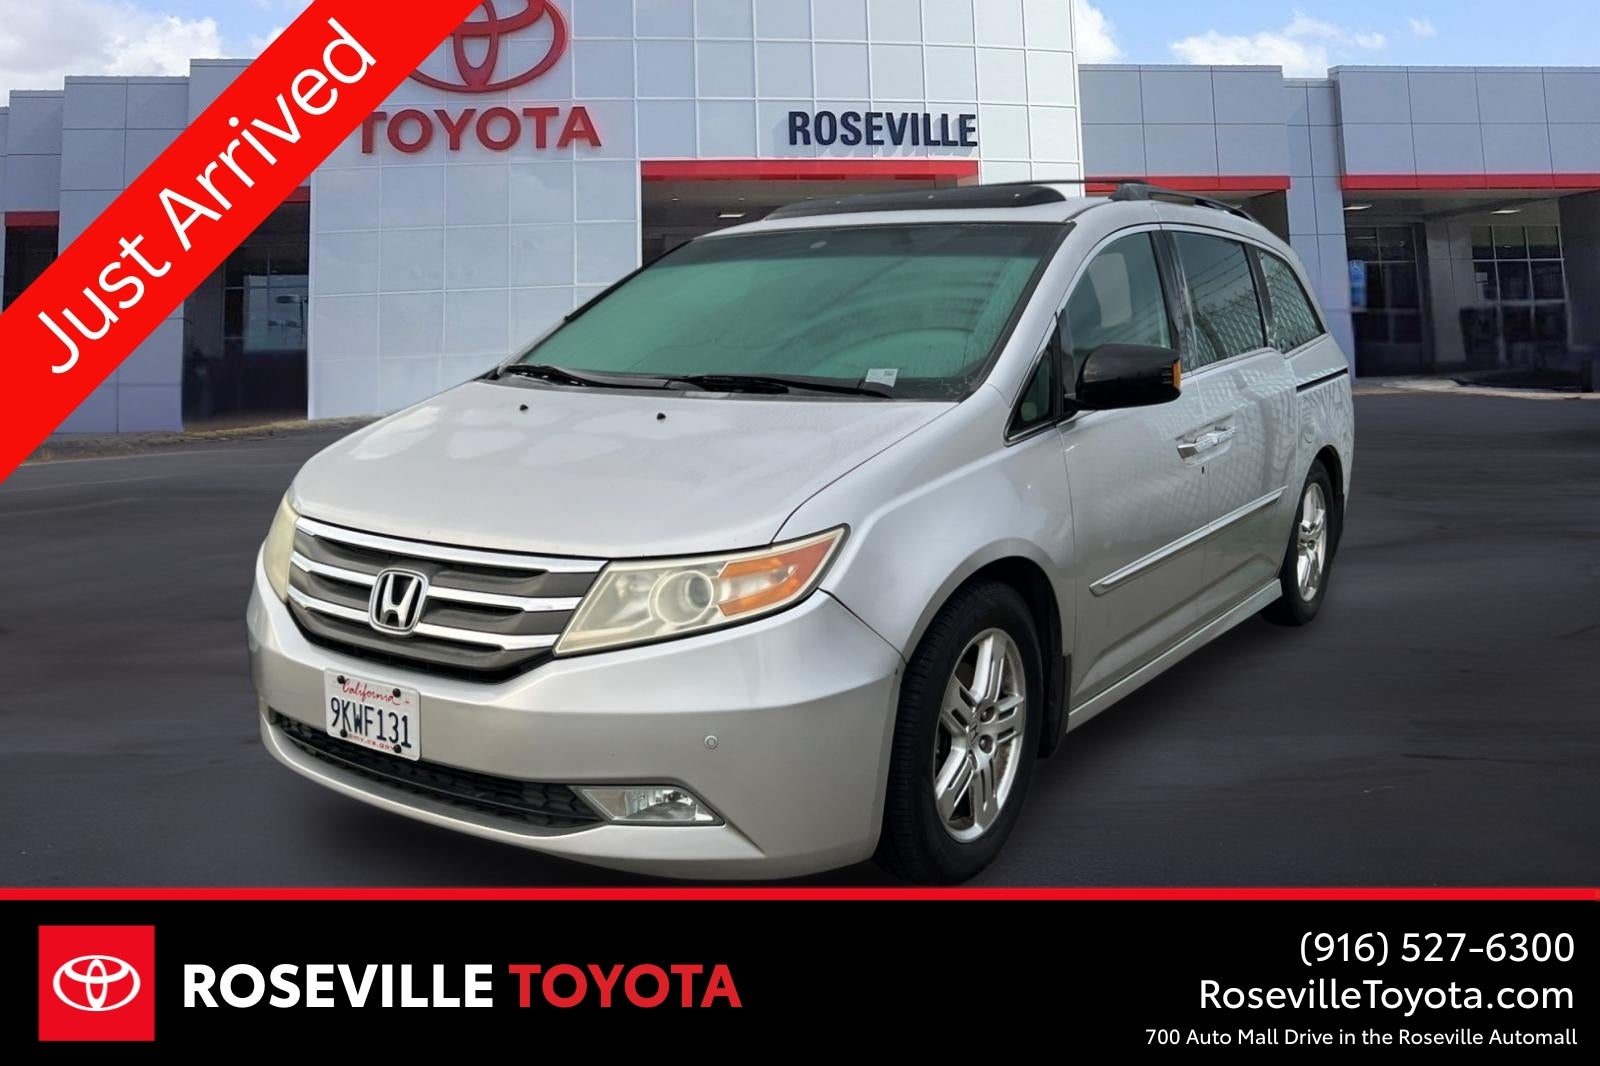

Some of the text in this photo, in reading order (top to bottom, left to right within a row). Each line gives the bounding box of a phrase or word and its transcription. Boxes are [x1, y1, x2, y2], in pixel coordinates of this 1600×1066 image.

[361, 106, 602, 154] TOYOTA
[788, 111, 978, 147] ROSEVILLE
[342, 678, 400, 706] California
[330, 696, 412, 749] 9KWF131
